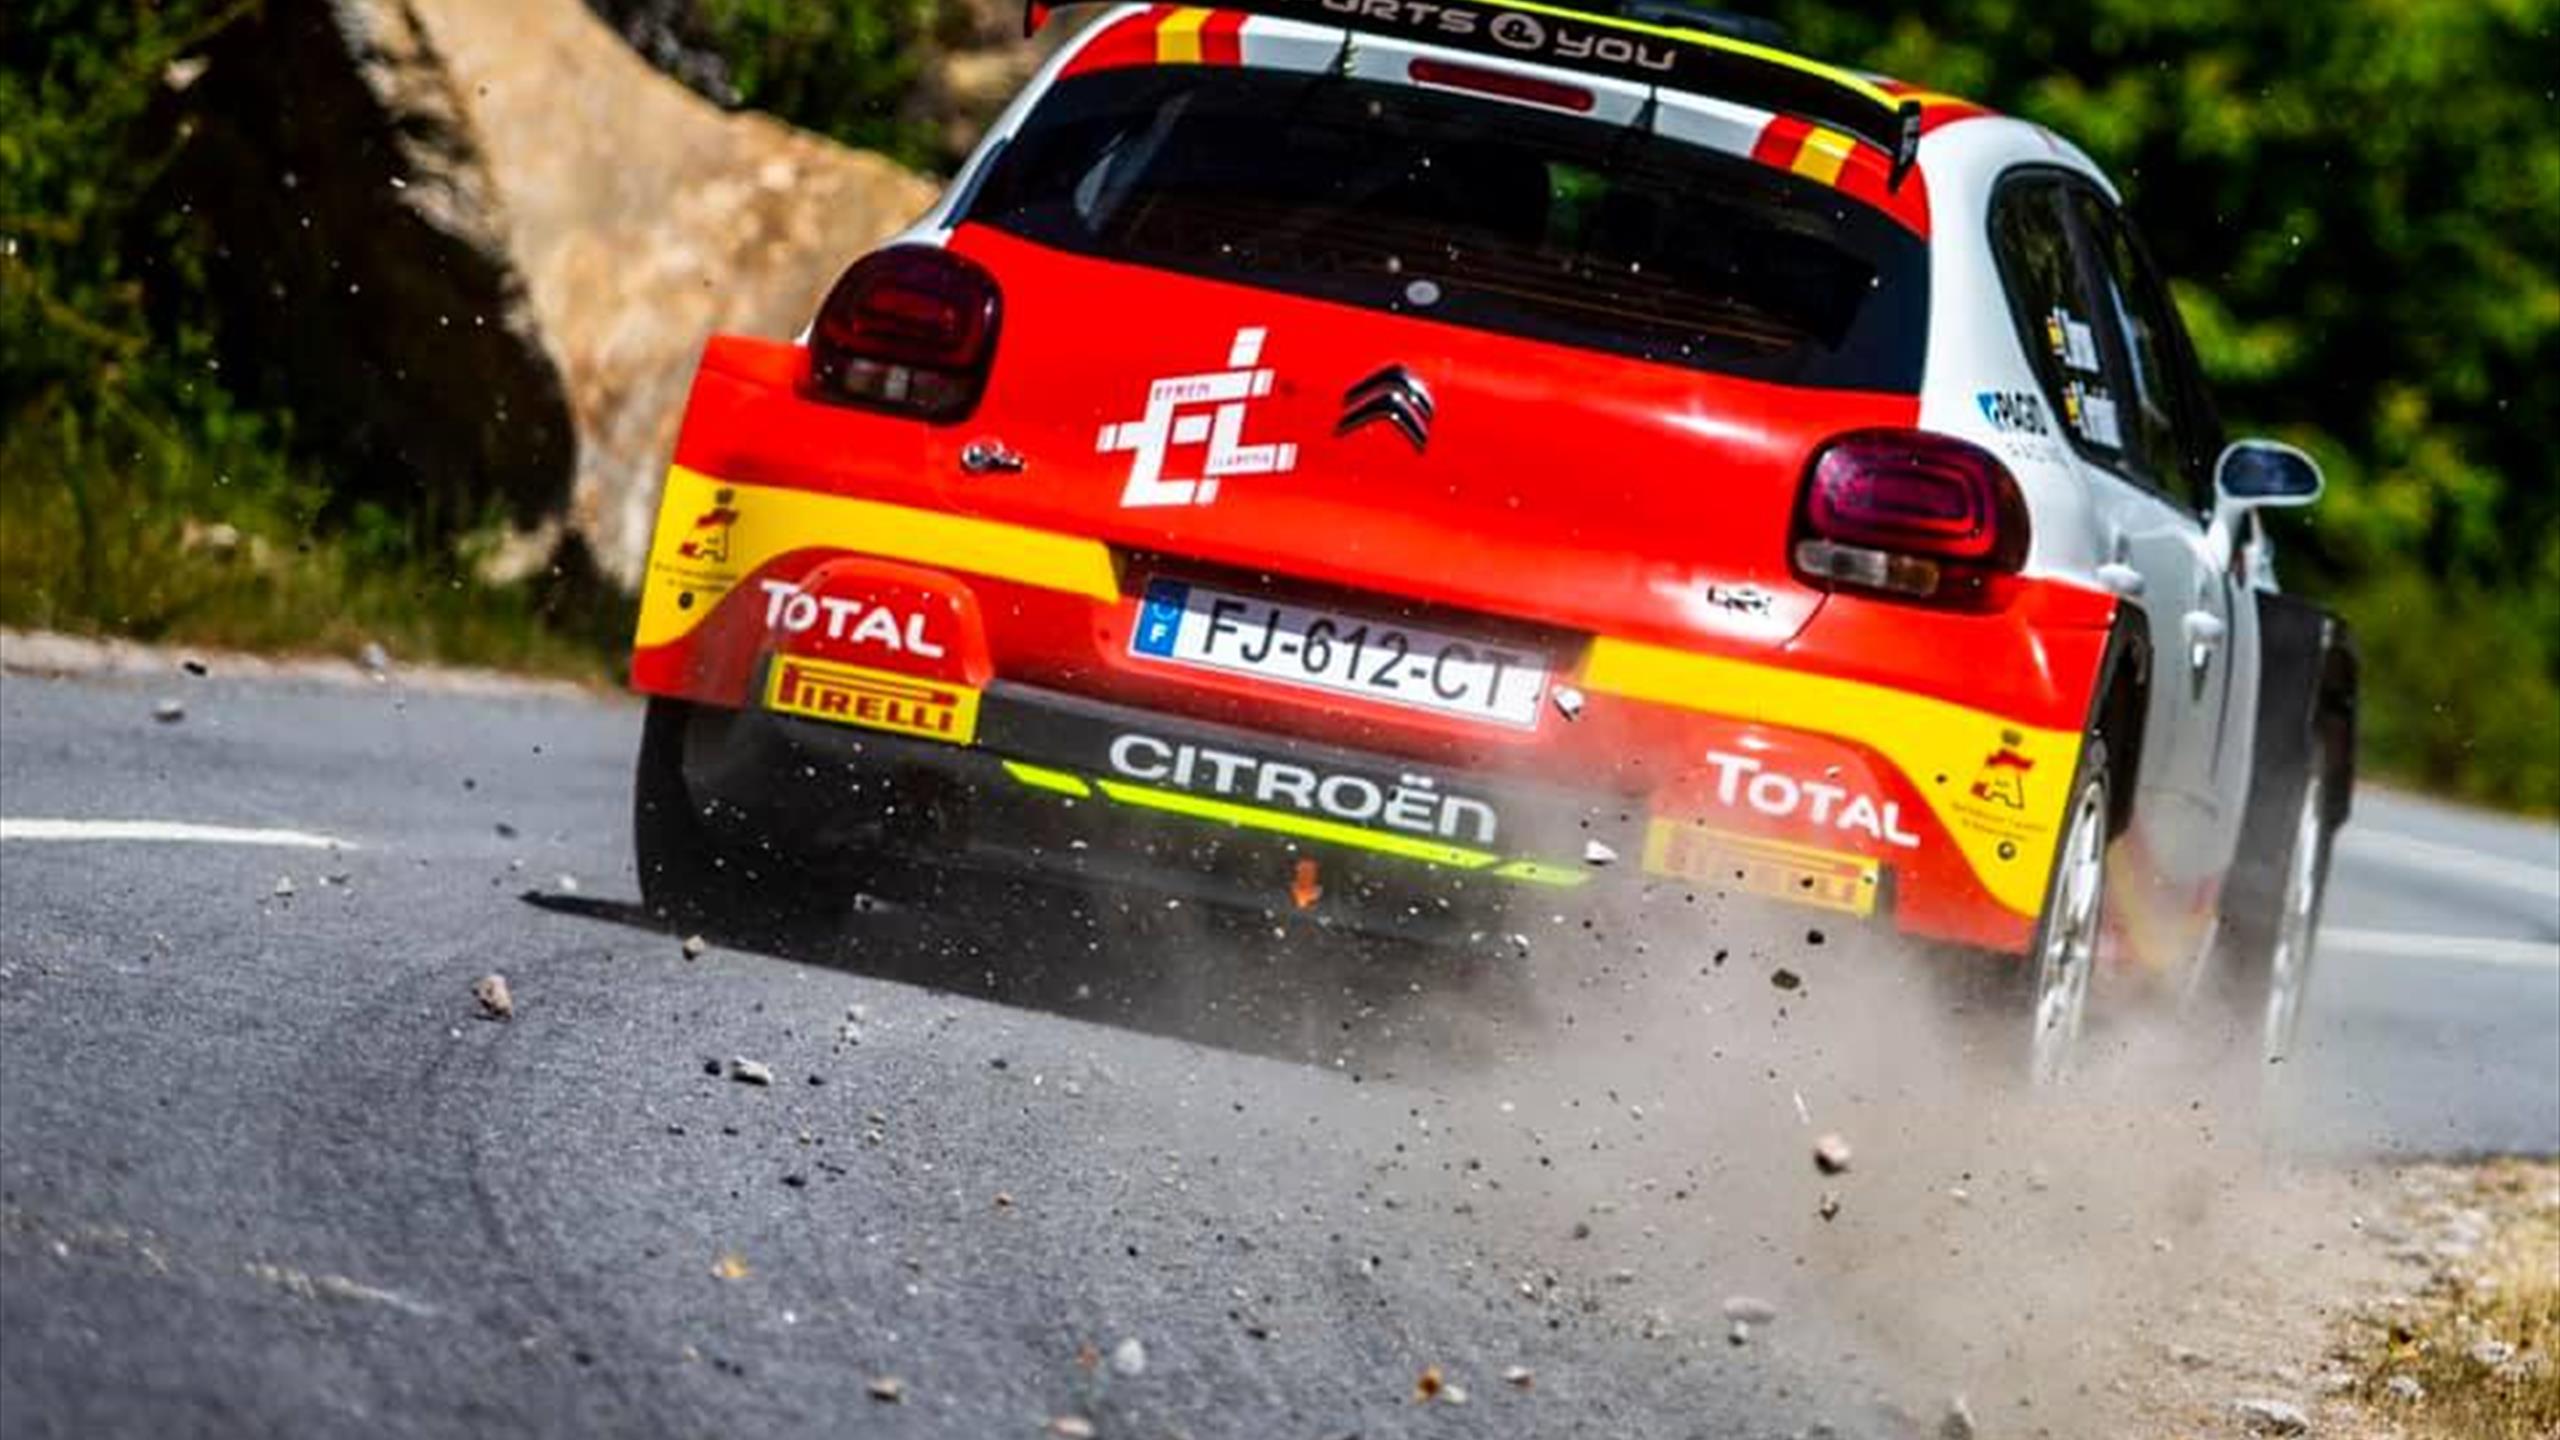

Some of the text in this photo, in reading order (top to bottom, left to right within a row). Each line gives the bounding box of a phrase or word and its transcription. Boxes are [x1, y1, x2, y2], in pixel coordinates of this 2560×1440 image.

[761, 581, 943, 658] TOTAL
[1203, 599, 1519, 706] FJ-612-CT
[779, 666, 958, 732] PIRELLI
[1706, 751, 1920, 847] TOTAL
